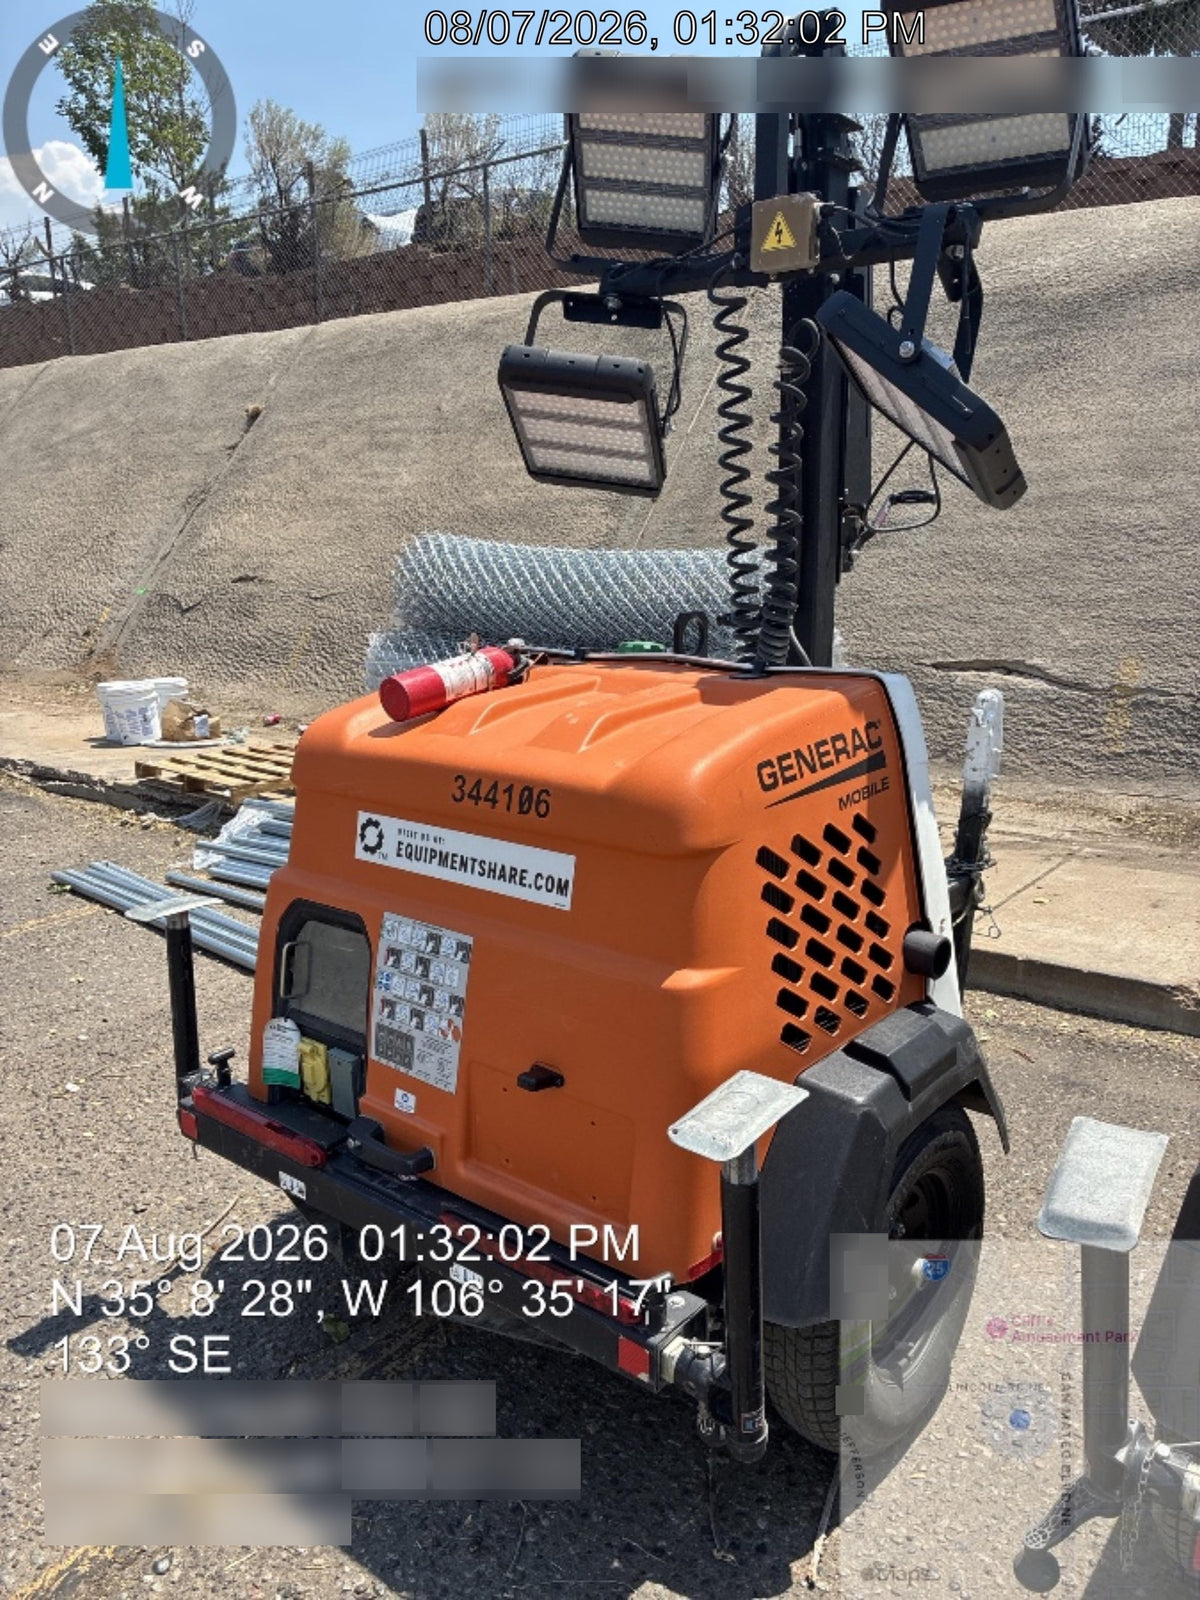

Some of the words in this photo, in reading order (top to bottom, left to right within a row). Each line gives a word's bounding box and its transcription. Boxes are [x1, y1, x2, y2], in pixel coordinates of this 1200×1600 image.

[756, 721, 883, 792] GENERAC
[451, 774, 551, 818] 344106
[838, 776, 890, 811] MOBILE
[396, 840, 570, 898] EQUIPMENTSHARE.COM
